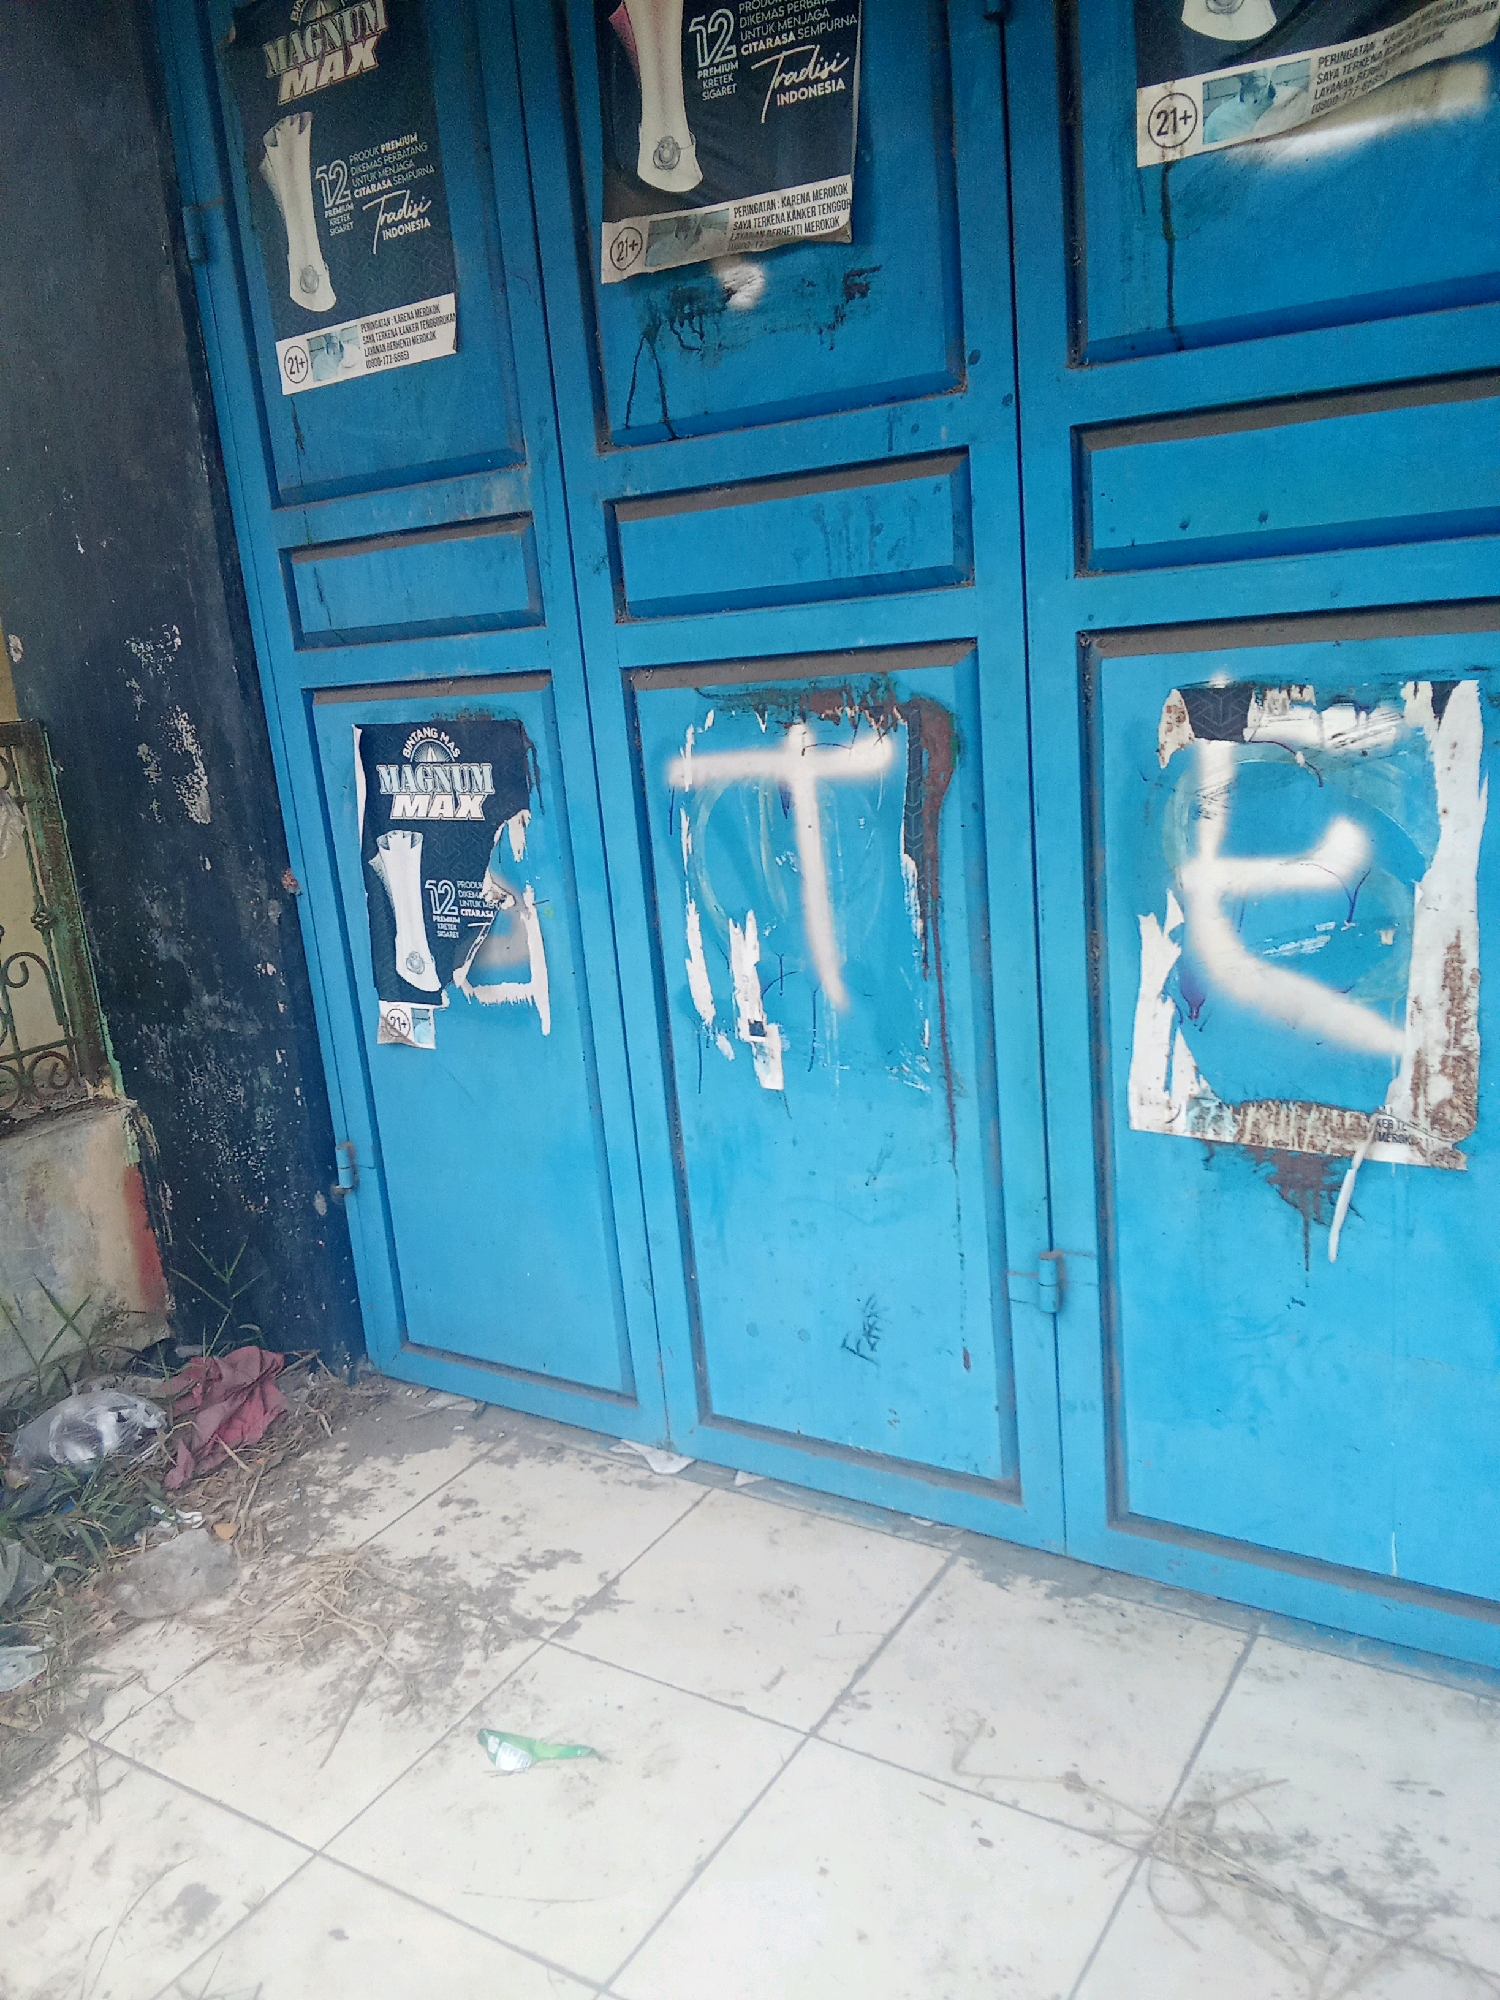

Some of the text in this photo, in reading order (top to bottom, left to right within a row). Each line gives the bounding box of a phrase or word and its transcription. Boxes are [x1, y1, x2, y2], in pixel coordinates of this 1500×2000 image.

[740, 6, 785, 29] DIKEMAS
[740, 7, 831, 42] UNTUK MENJAGA
[263, 0, 388, 78] MAGNUM
[740, 14, 858, 55] CITARASA SEMPURNA
[278, 32, 379, 105] MAX
[697, 60, 739, 79] PREMIUM
[702, 73, 734, 90] KRETEK
[1316, 68, 1340, 86] SAYA
[701, 84, 737, 101] SIGARET
[776, 78, 846, 107] INDONESIA
[1156, 107, 1192, 136] 21+
[349, 132, 418, 165] PRODUK PREMIUM
[350, 142, 428, 177] DIKEMAS PERBATANG
[351, 159, 416, 188] UNTUK MENJAGA
[353, 164, 435, 199] CITARASA SEMPURNA
[324, 202, 354, 218] PREMIUM
[733, 198, 777, 218] PERINGATAN
[781, 191, 811, 207] KARENA
[812, 182, 849, 201] MEROKOK
[382, 217, 431, 240] INDONESIA
[732, 218, 752, 231] SAYA
[753, 211, 786, 229] TERKENA
[787, 205, 817, 222] KANKER
[804, 215, 840, 234] MEROKOK
[616, 237, 639, 263] 21+
[288, 354, 306, 375] 21+
[402, 726, 461, 758] BINTANG MAS
[376, 763, 496, 794] MAGNUM
[390, 793, 488, 821] MAX
